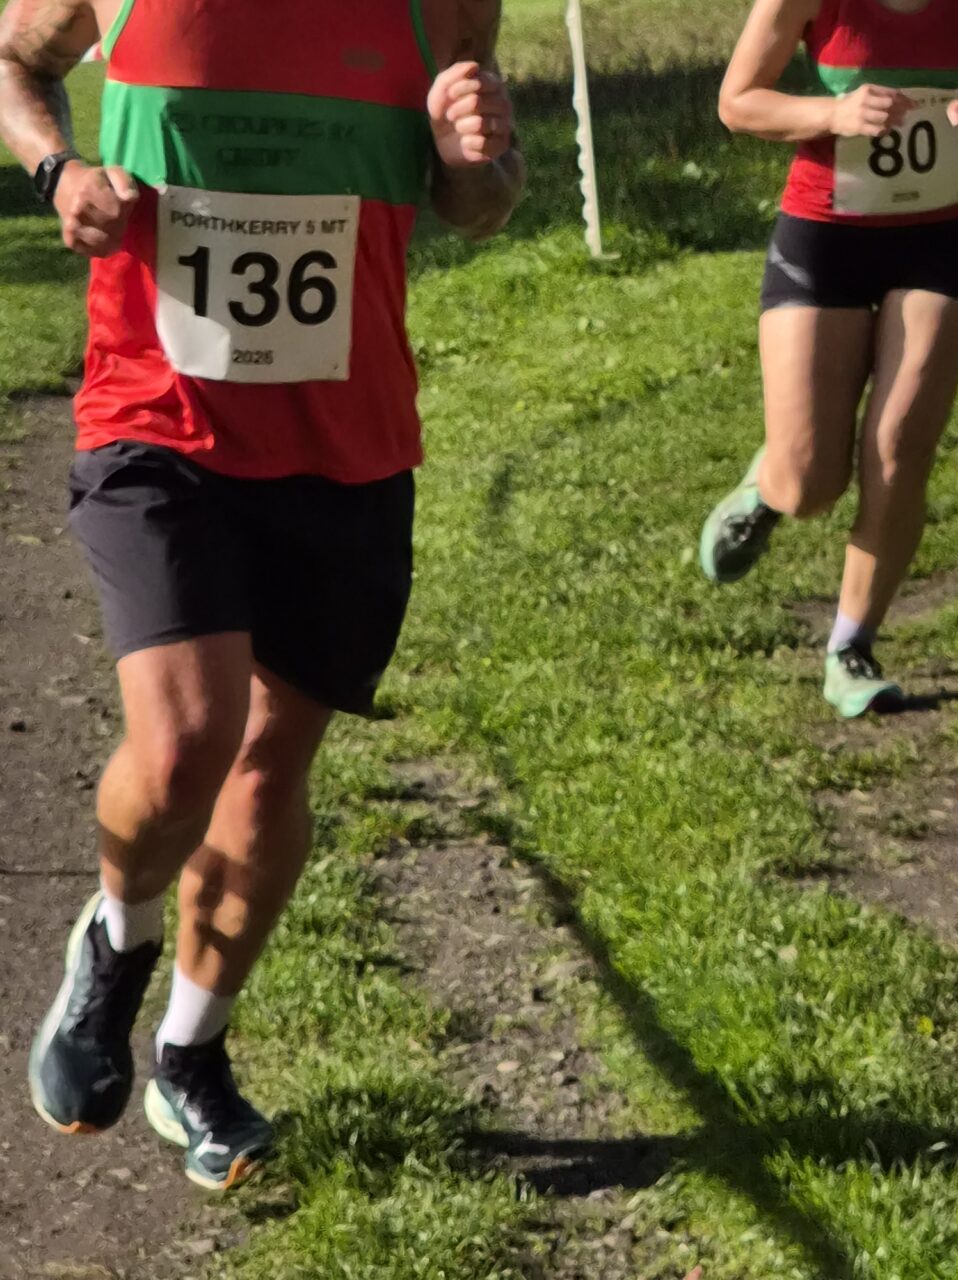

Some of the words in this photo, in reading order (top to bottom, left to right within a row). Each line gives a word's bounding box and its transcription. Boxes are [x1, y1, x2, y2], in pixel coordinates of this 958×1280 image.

[868, 120, 937, 178] 80
[170, 209, 301, 235] PORTHKERRY
[306, 219, 316, 235] 5
[321, 218, 348, 235] MT
[177, 246, 338, 327] 136
